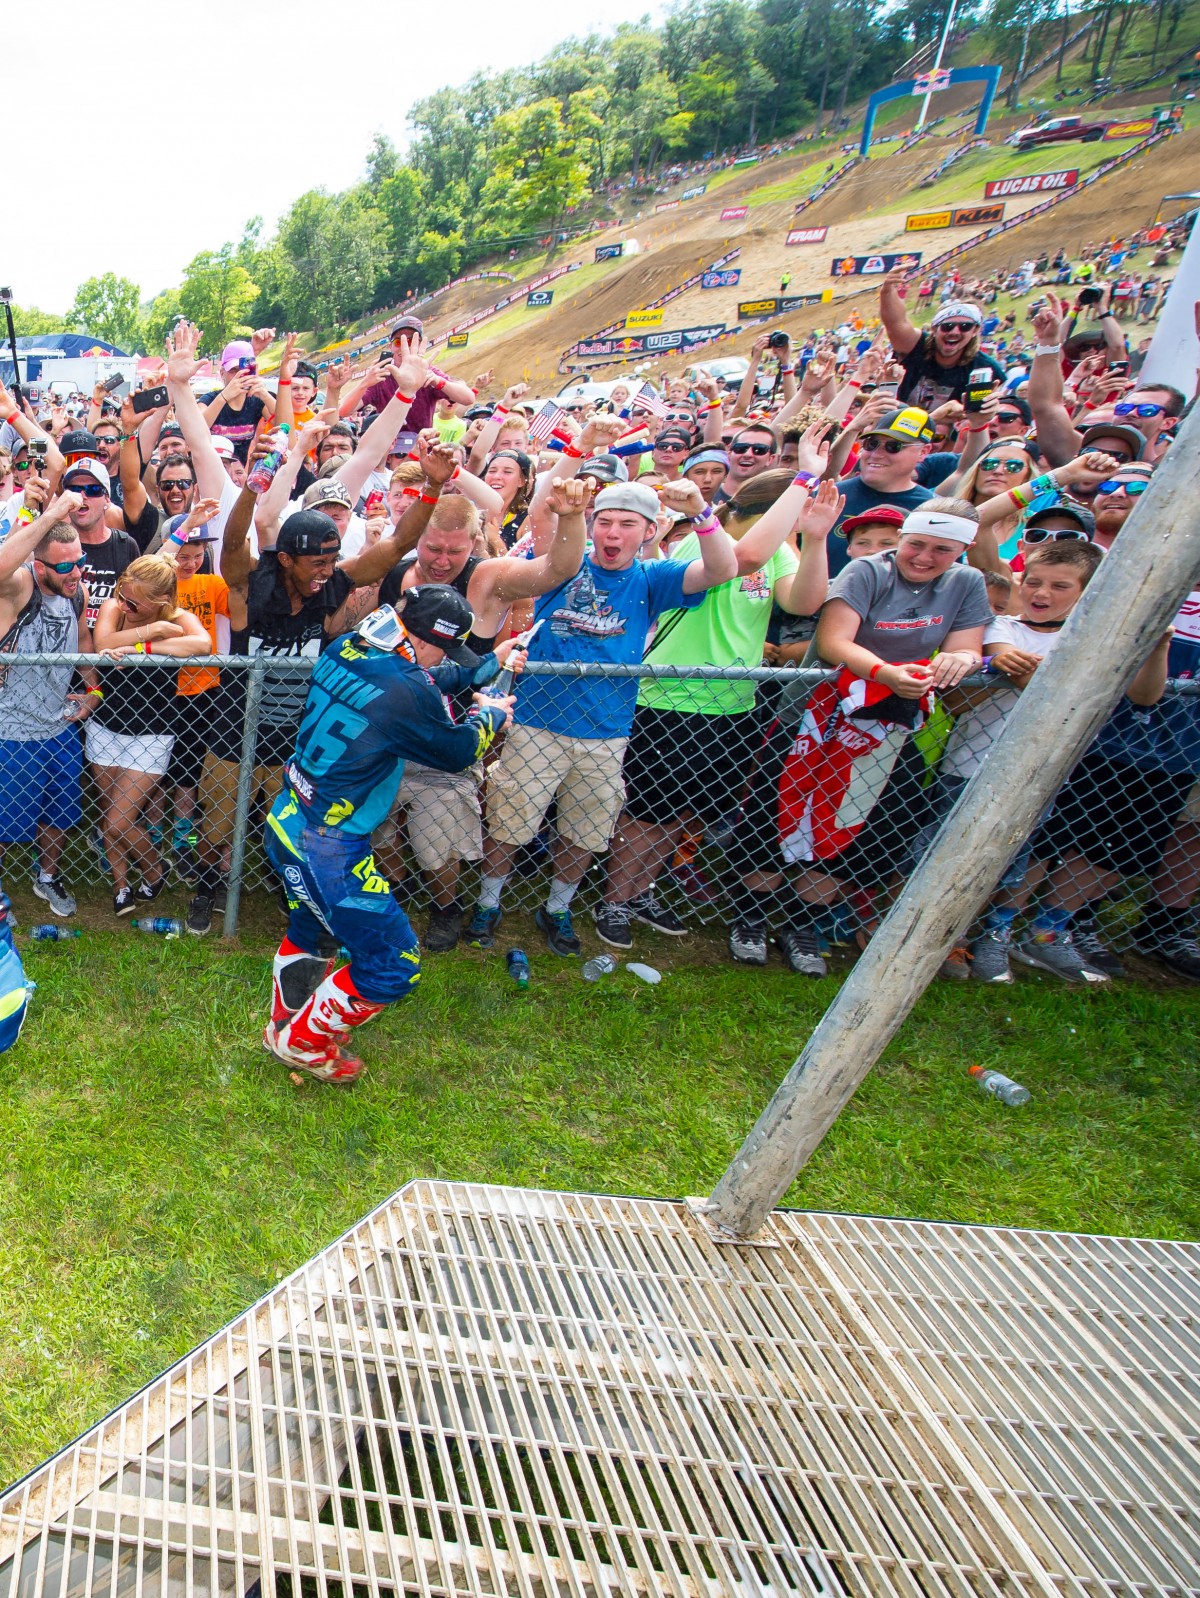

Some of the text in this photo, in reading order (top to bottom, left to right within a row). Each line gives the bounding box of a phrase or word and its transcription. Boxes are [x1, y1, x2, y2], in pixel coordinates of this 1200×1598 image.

[990, 171, 1069, 197] LUCAS OIL
[955, 209, 1001, 223] KTM
[787, 228, 827, 245] FRAM
[628, 313, 663, 323] SUZUKI
[579, 341, 596, 354] Red
[596, 341, 612, 353] Bull
[647, 332, 682, 348] WPS
